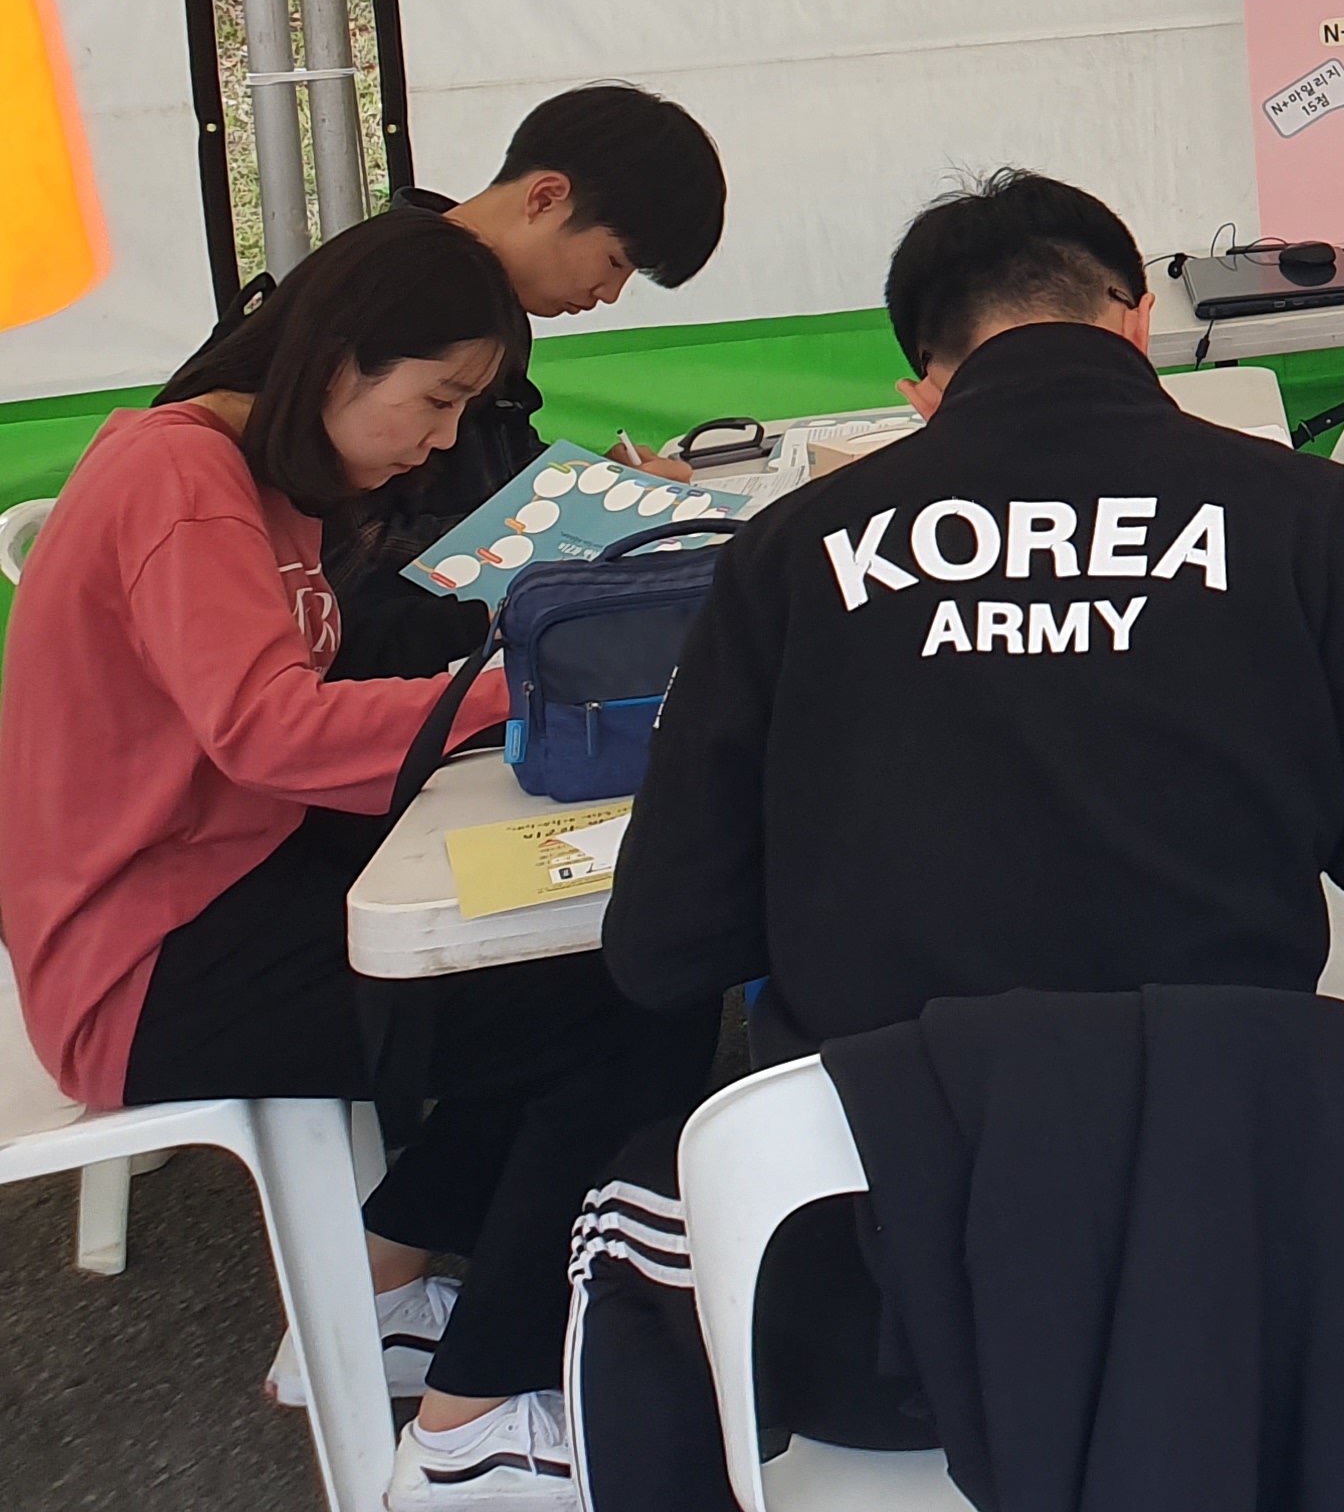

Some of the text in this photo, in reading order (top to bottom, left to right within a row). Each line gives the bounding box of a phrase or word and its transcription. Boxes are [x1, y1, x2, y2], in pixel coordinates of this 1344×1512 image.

[1271, 65, 1342, 116] N+마일리지
[1301, 92, 1331, 117] 15점
[822, 496, 1228, 613] KOREA
[921, 595, 1148, 658] ARMY
